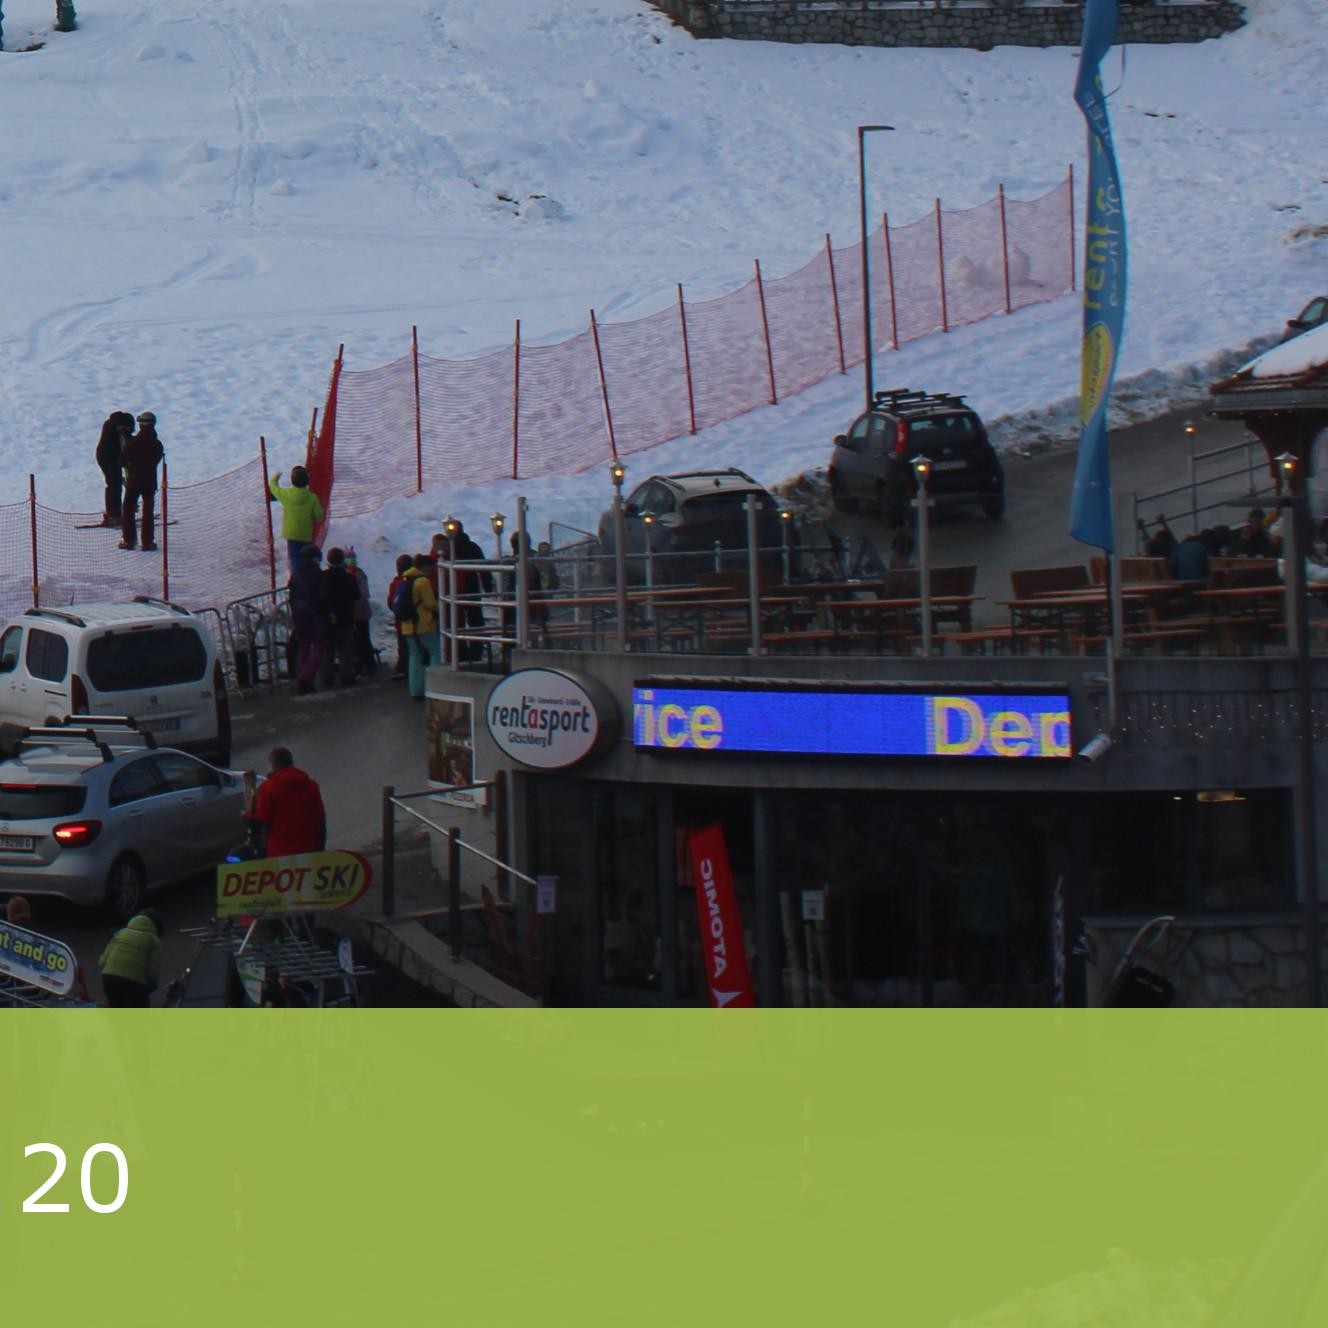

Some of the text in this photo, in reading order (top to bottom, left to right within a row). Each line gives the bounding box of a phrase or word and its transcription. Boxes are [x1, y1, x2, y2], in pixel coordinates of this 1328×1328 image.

[492, 695, 590, 746] rentasport
[222, 863, 360, 897] DEPOT SKI
[13, 939, 45, 961] and
[46, 952, 67, 970] go
